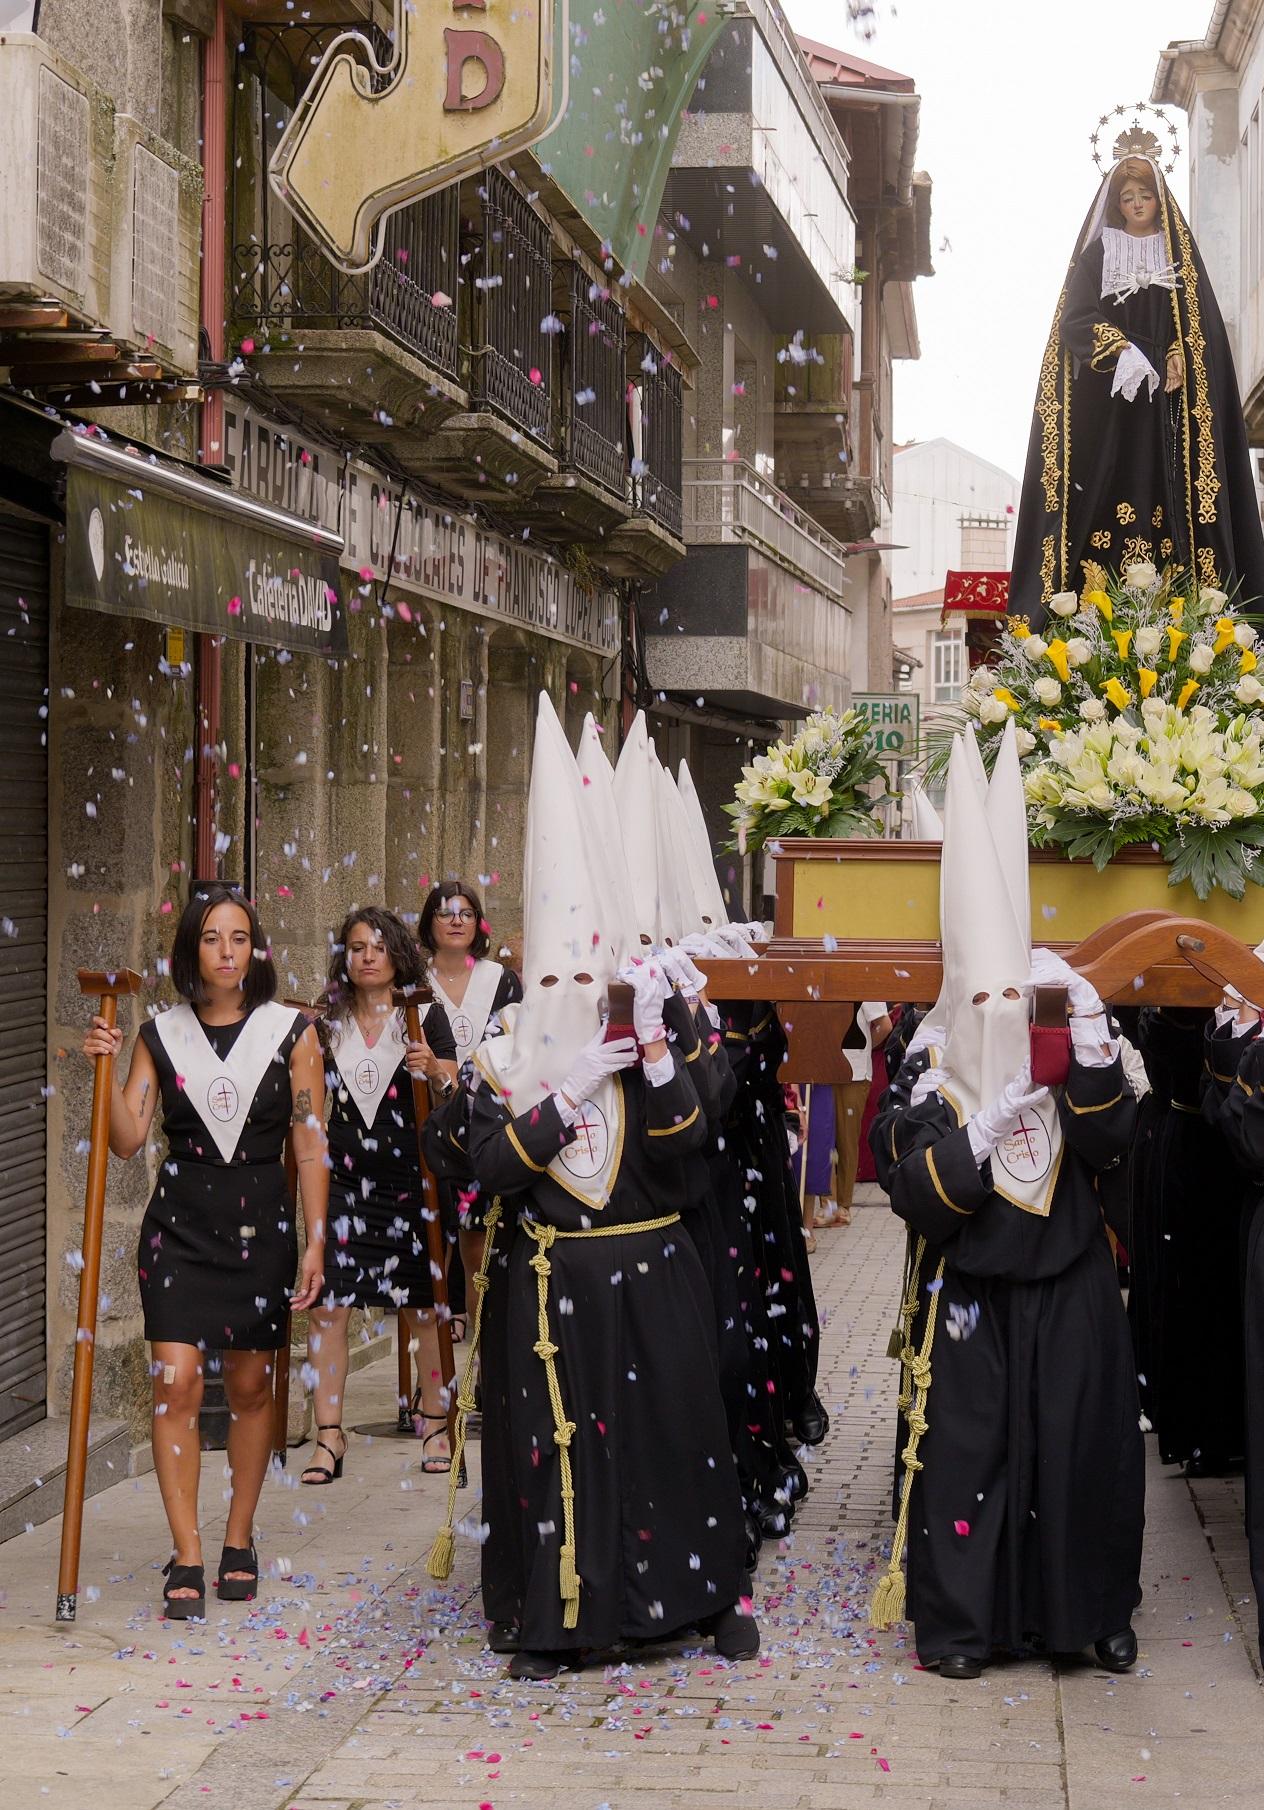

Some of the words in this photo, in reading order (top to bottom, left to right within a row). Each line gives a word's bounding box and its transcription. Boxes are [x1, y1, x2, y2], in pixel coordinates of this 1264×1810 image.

[125, 535, 160, 582] Estrella
[160, 546, 189, 590] Galicia
[473, 532, 490, 605] DE
[496, 541, 560, 630] FRANCISCO
[298, 573, 332, 632] DAVID
[565, 1145, 598, 1160] Cristo
[1004, 1136, 1036, 1152] Santo
[1006, 1150, 1040, 1164] Cristo
